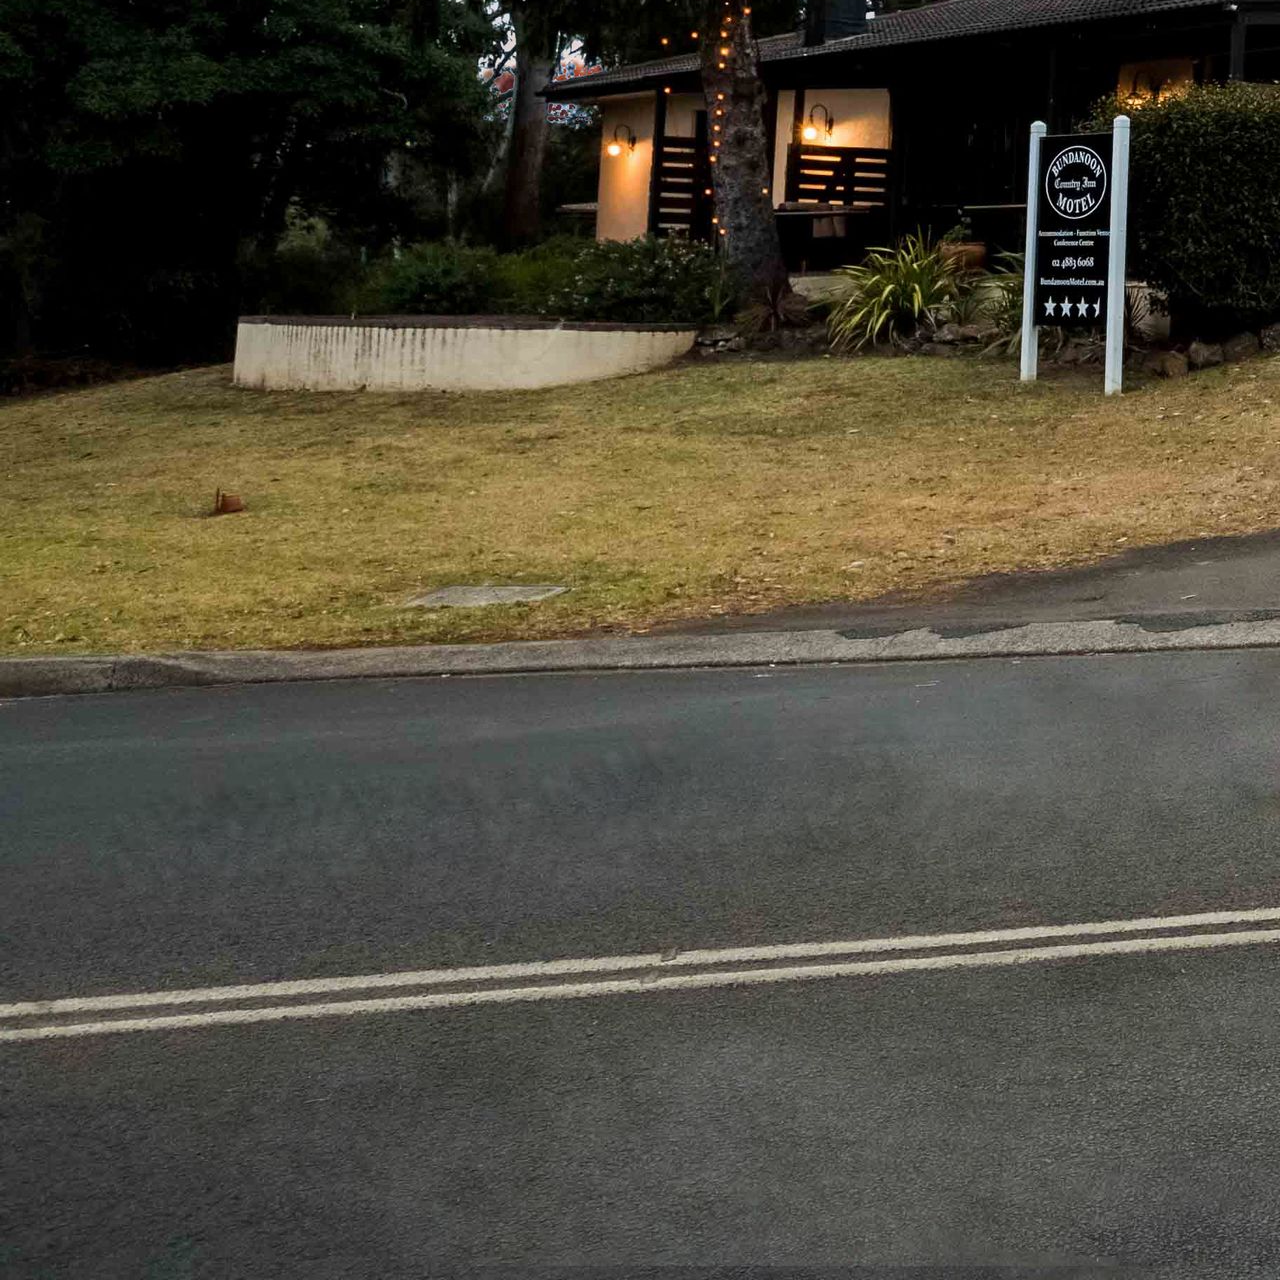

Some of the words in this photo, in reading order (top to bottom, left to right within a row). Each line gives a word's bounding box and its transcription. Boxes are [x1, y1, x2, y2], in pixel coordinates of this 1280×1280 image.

[1052, 151, 1102, 178] BUNDANOON
[1054, 177, 1081, 191] Country
[1081, 176, 1097, 191] Inn
[1056, 192, 1095, 213] MOTEL
[1061, 257, 1077, 269] 4883
[1077, 256, 1094, 267] 6068
